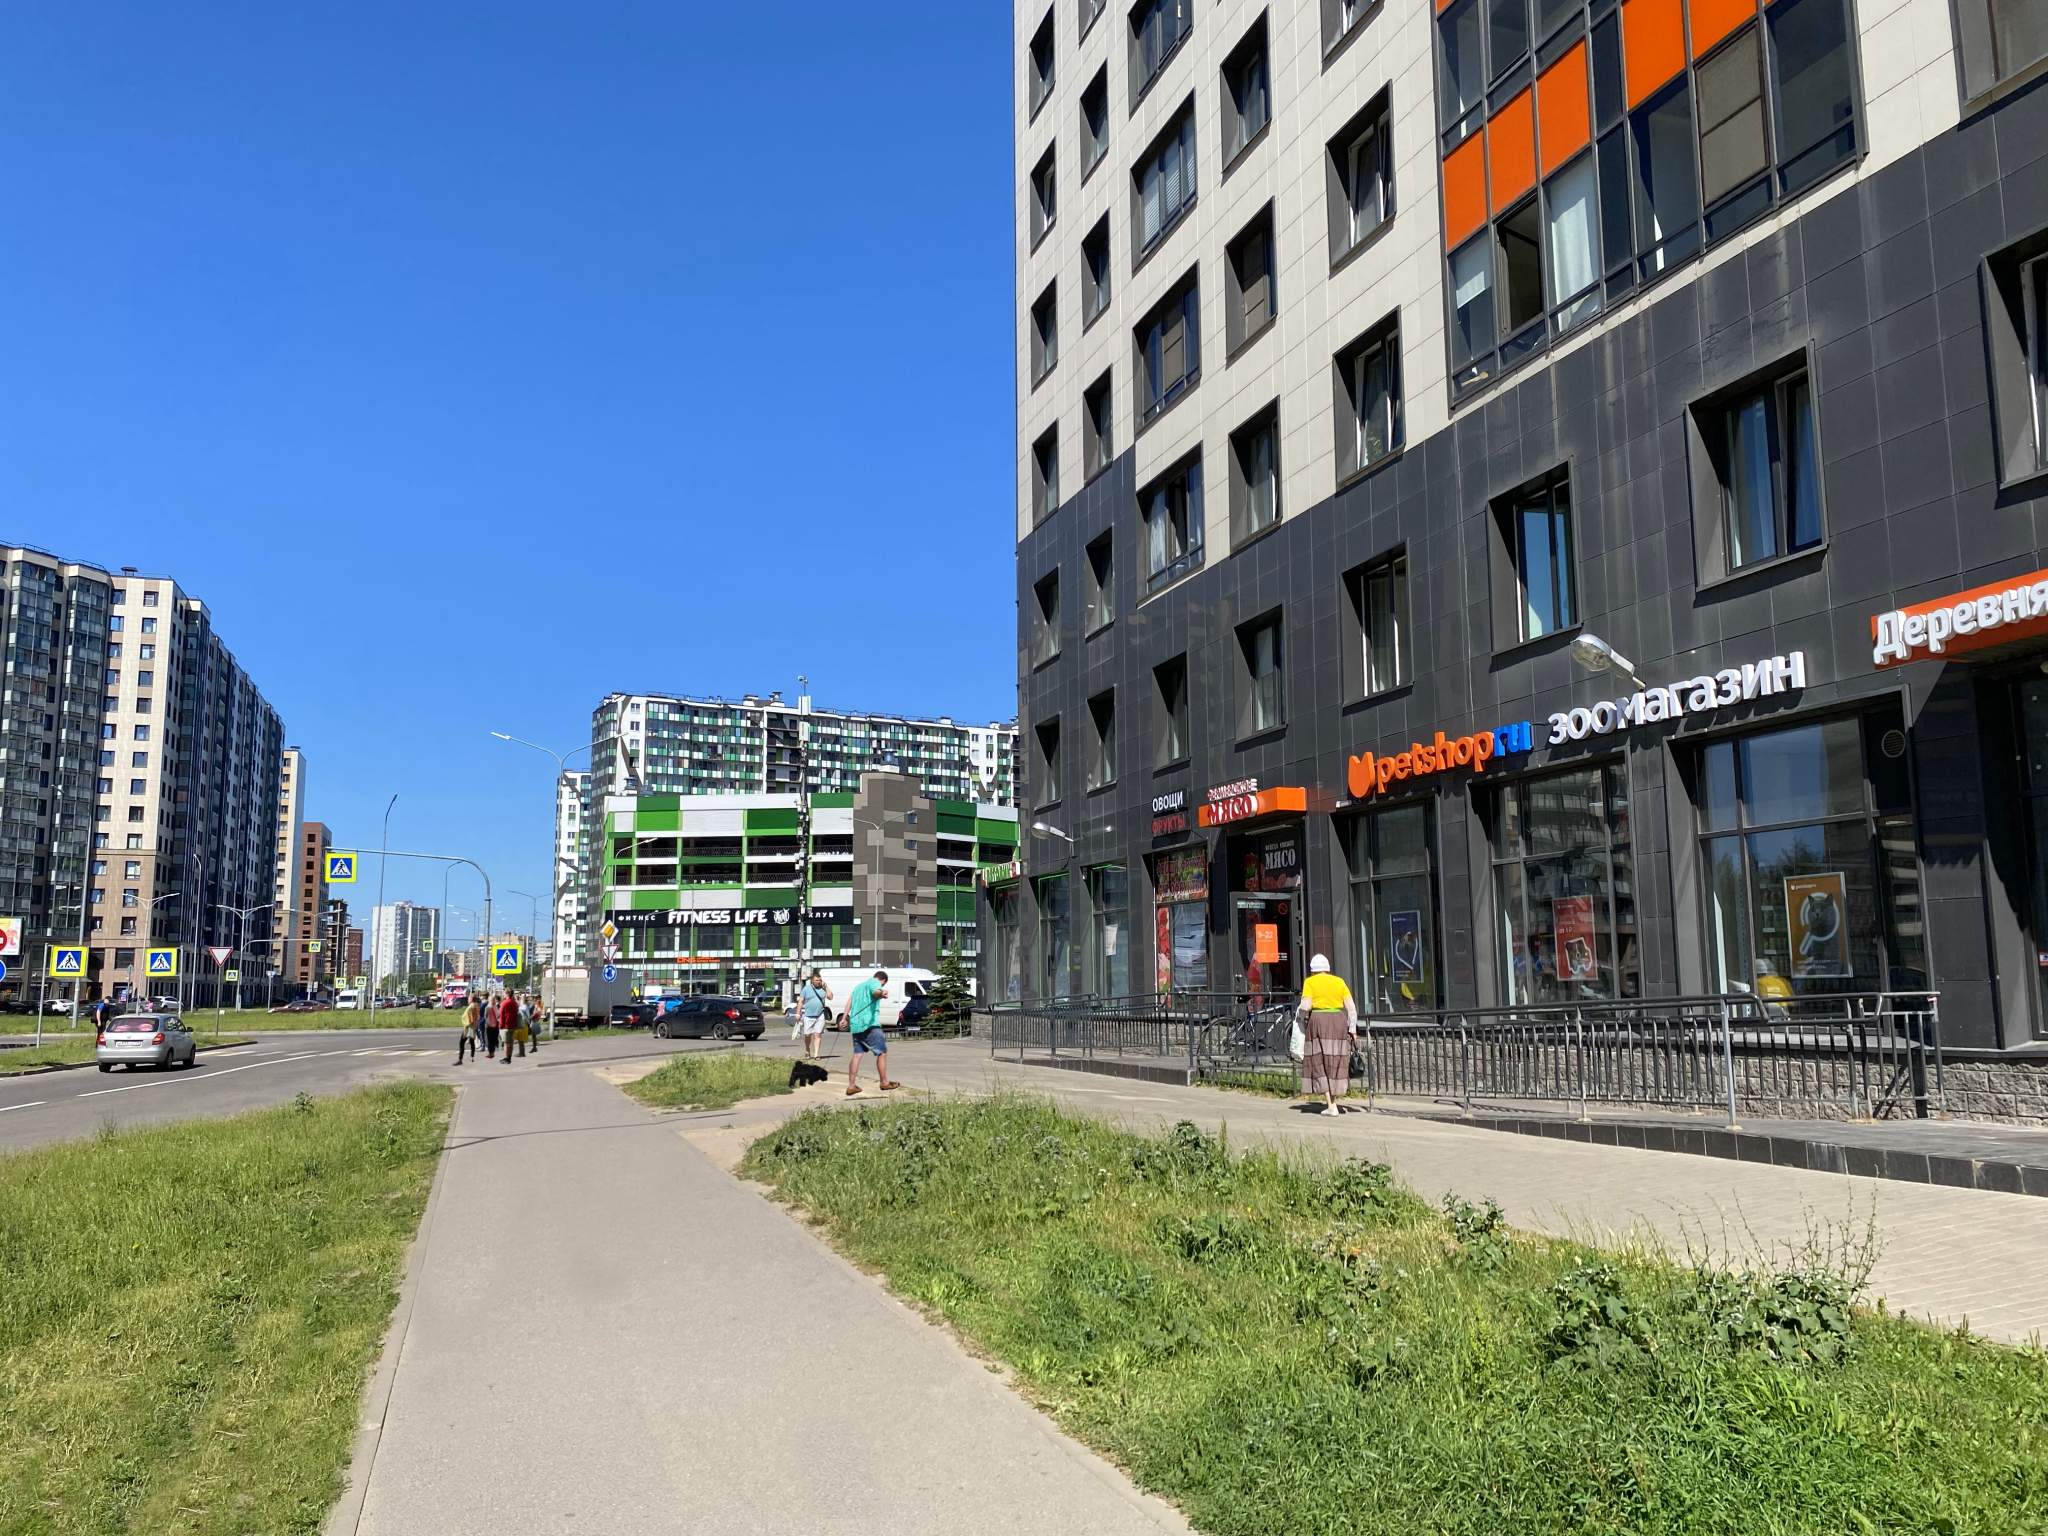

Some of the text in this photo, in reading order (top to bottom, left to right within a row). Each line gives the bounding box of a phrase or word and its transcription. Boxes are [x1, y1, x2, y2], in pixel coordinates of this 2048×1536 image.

[1873, 580, 2048, 665] Деревня
[1547, 651, 1806, 745] зоомагазин
[1152, 790, 1183, 812] ОВОЩИ
[1265, 848, 1296, 870] МЯСО
[667, 910, 731, 925] FITNESS
[734, 909, 768, 924] LIFE
